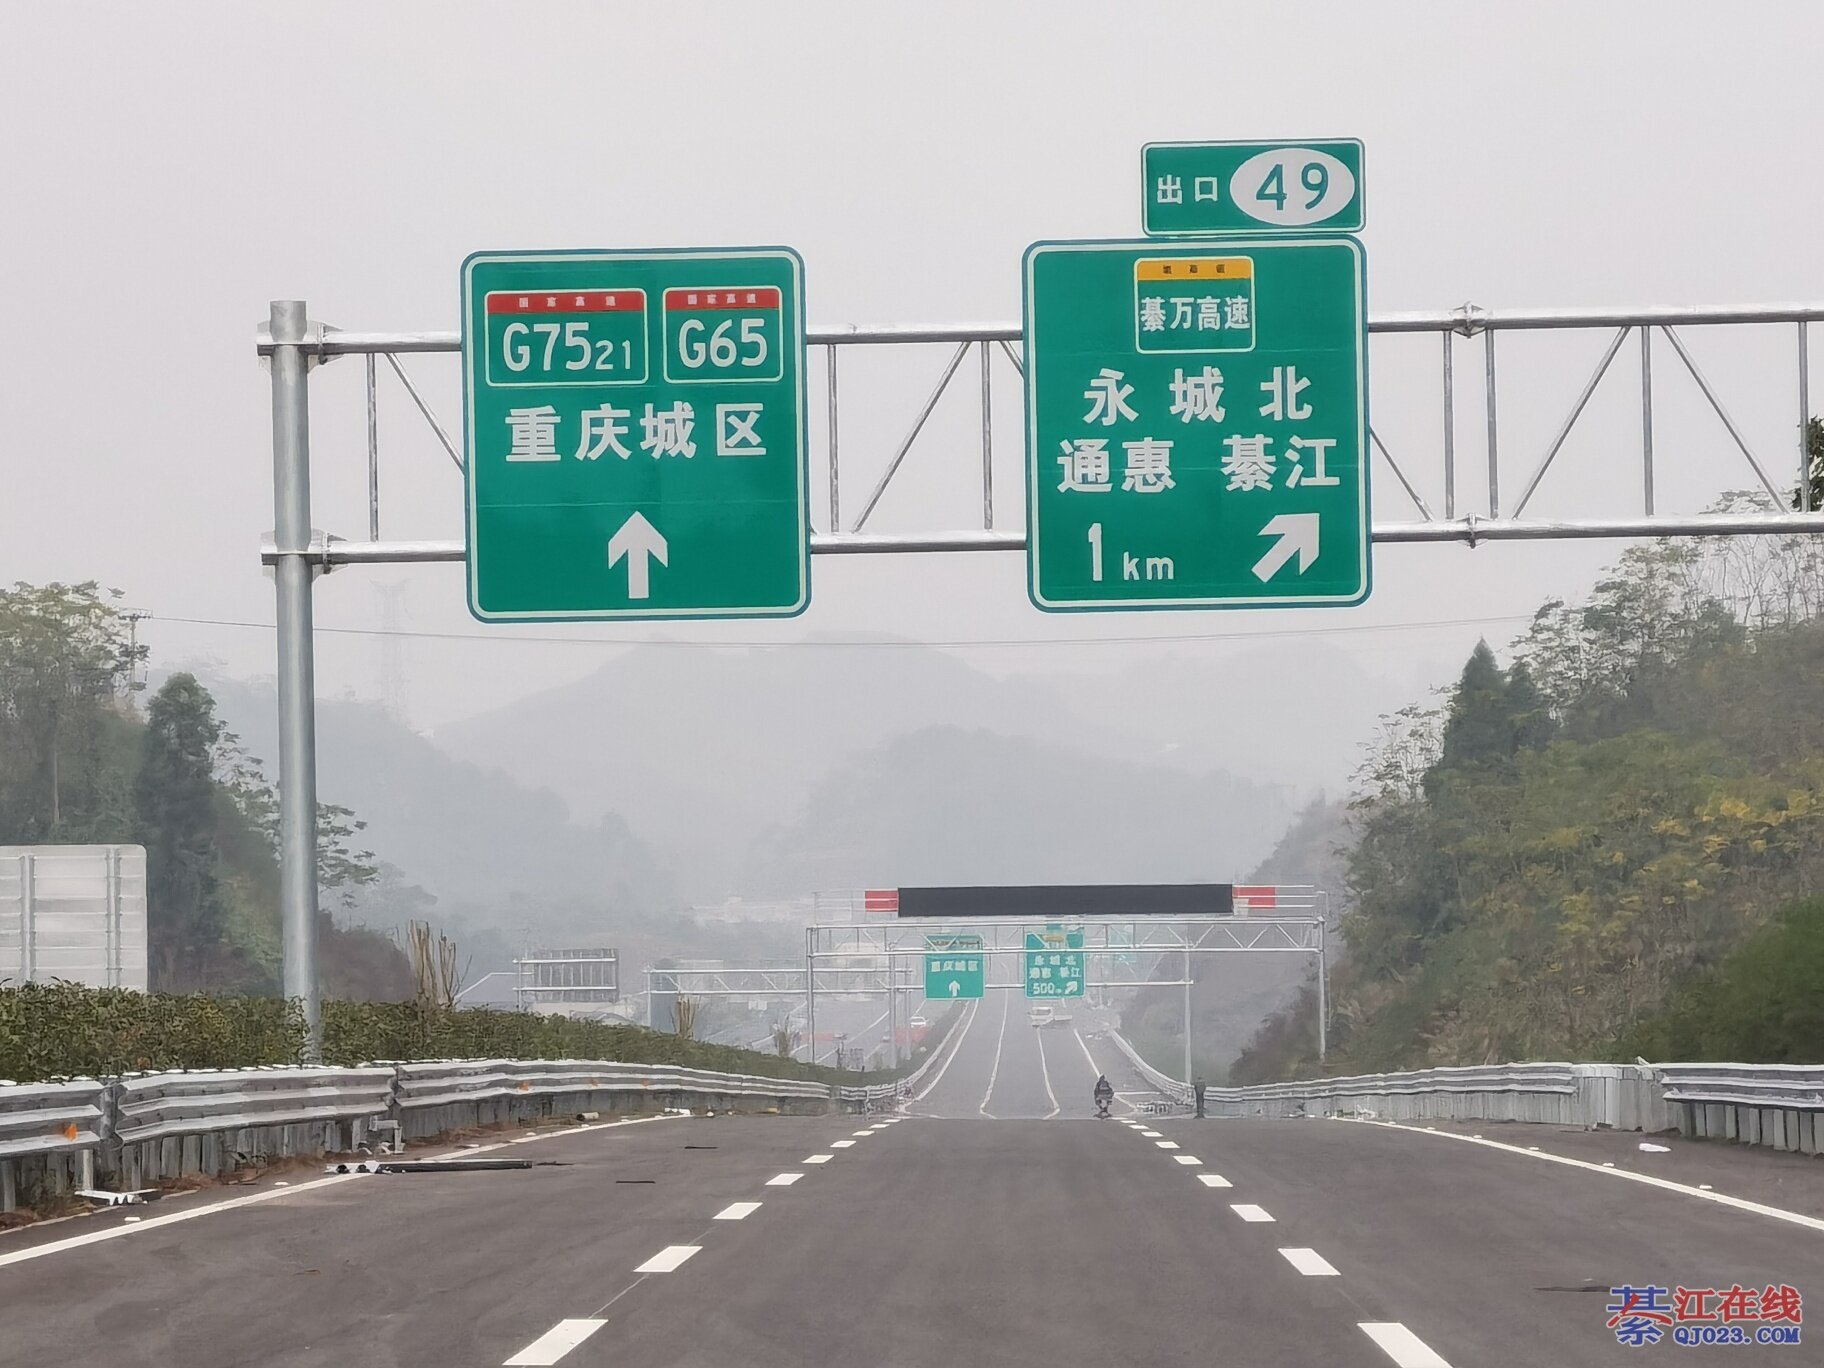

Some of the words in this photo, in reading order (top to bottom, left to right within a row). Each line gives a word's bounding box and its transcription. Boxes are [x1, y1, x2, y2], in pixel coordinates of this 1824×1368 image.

[1156, 174, 1219, 204] 出口
[1255, 162, 1329, 211] 49
[1140, 295, 1251, 332] 綦万高速
[678, 318, 768, 368] G65
[1082, 365, 1313, 426] 永城北
[505, 401, 767, 462] 重庆城区
[1056, 437, 1177, 493] 通惠
[1221, 434, 1341, 491] 綦江
[1087, 522, 1103, 582] 1
[1123, 552, 1175, 581] km
